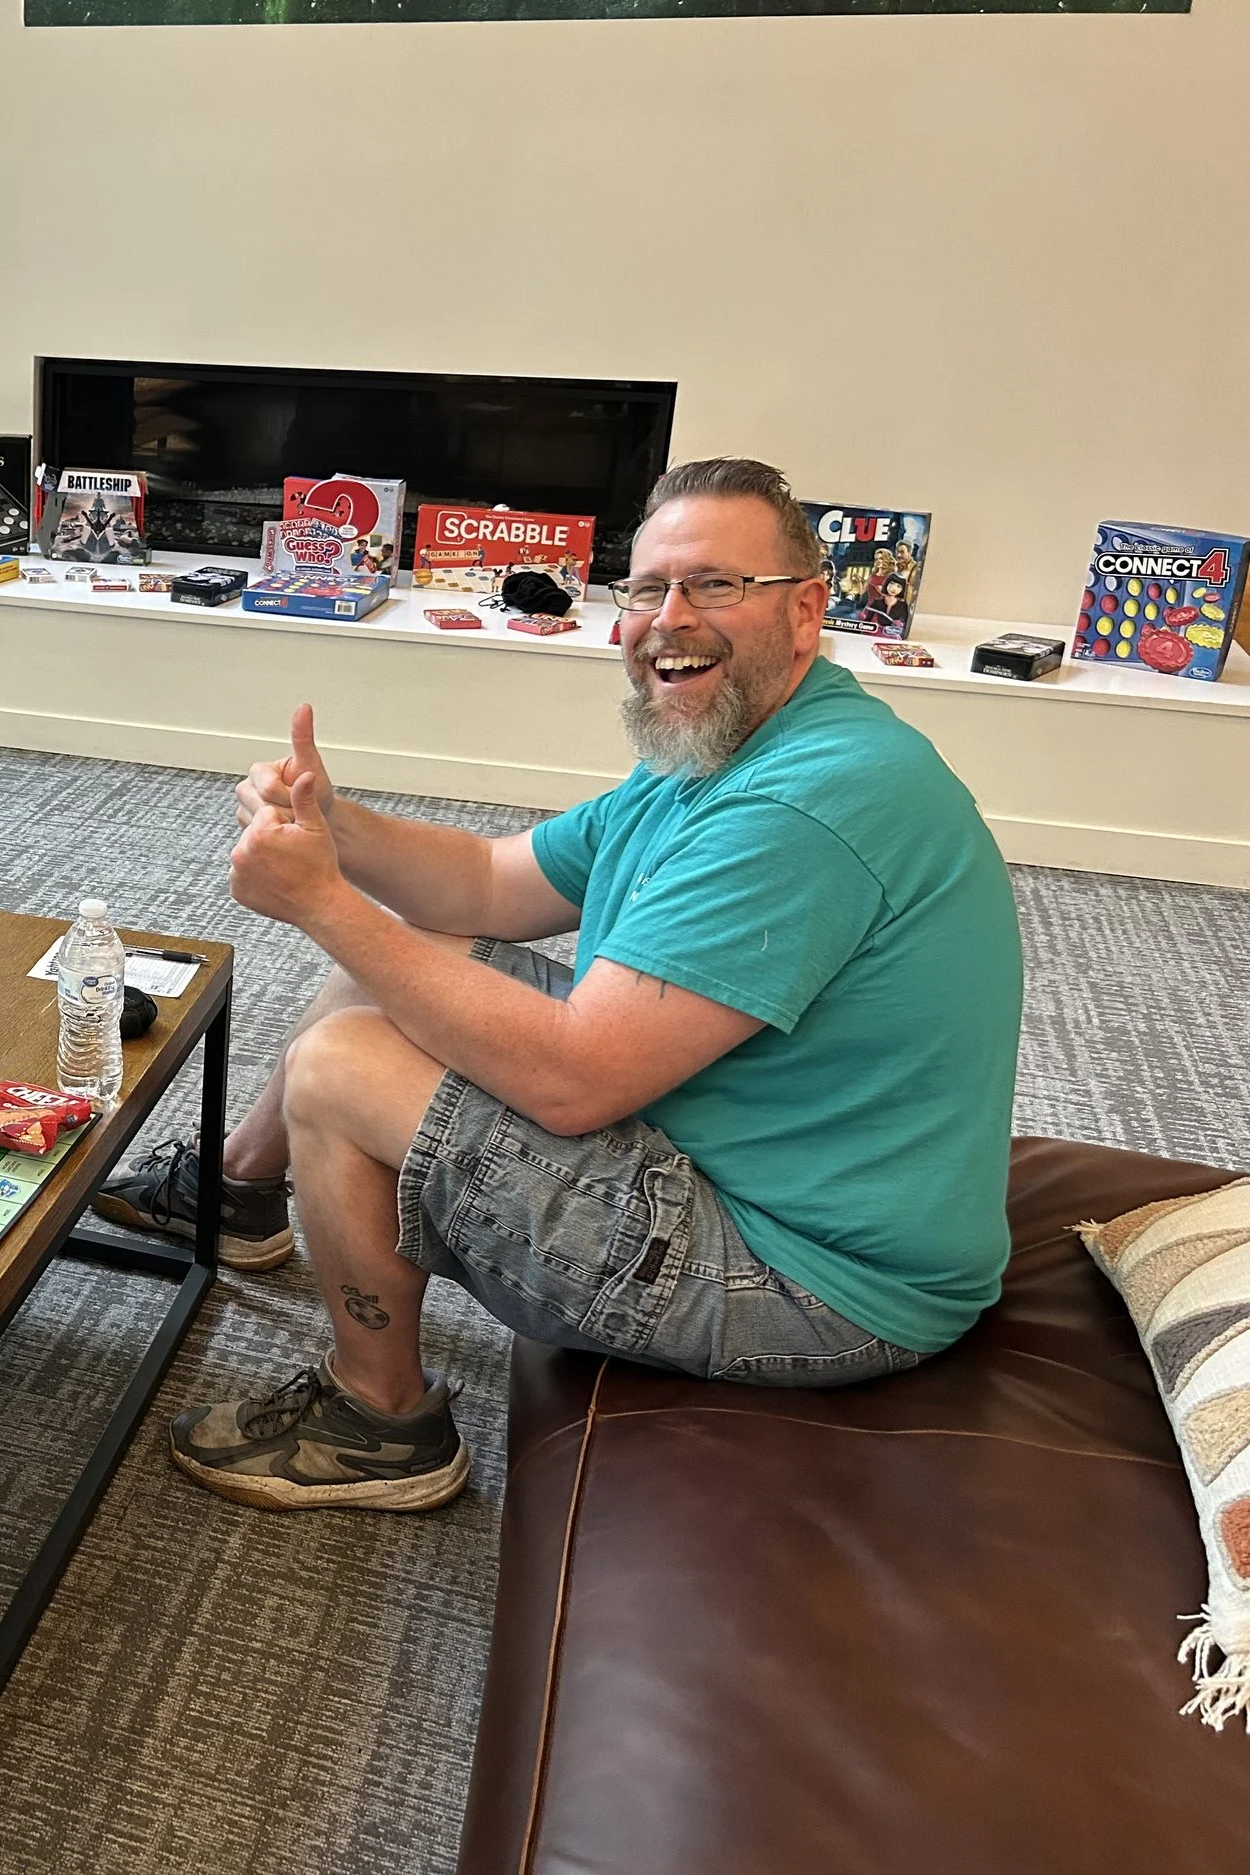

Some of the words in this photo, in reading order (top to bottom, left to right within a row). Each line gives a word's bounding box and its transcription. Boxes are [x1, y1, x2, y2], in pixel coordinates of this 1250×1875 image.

[68, 475, 132, 492] BATTLESHIP
[443, 518, 569, 546] SCRABBLE
[818, 510, 890, 543] CLUE
[1161, 546, 1184, 554] game
[1098, 555, 1201, 577] CONNECT
[1198, 551, 1226, 583] 4
[835, 620, 857, 629] Mystery
[858, 622, 874, 631] Game
